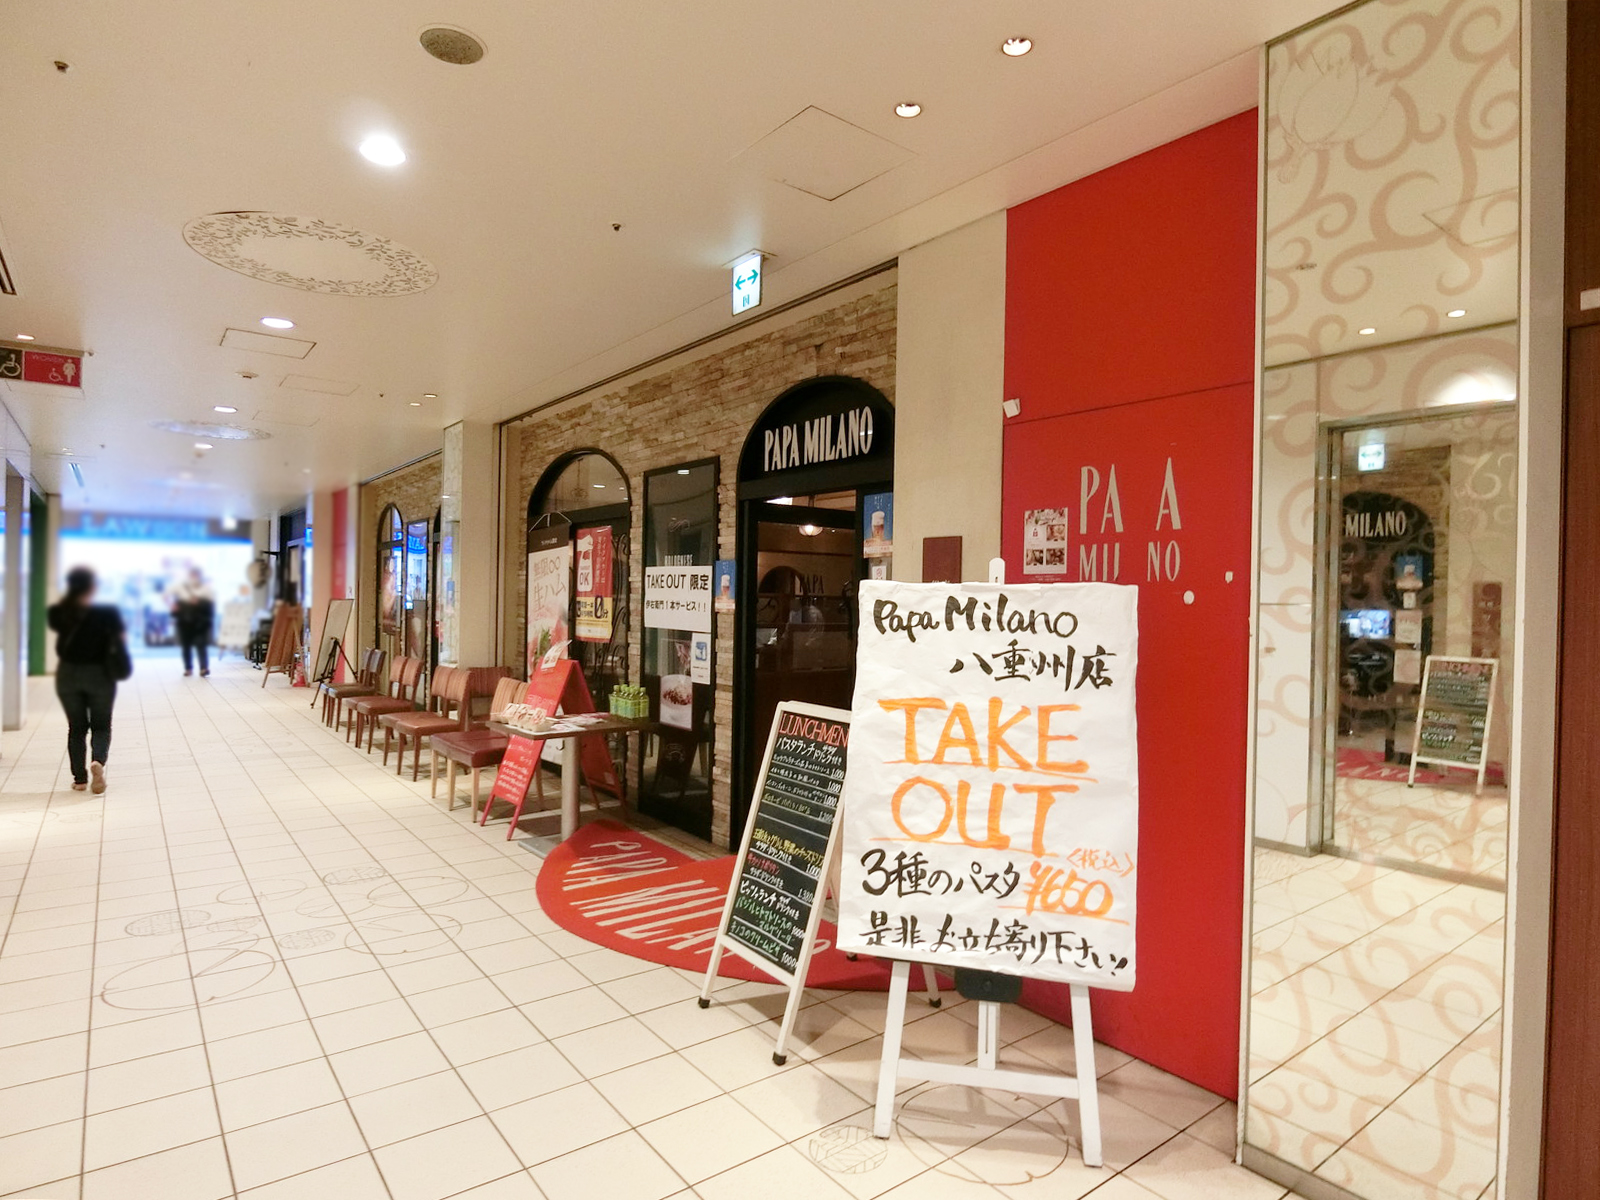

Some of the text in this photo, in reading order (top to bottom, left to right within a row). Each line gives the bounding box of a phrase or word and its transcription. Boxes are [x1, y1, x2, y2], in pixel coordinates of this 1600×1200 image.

[764, 406, 873, 472] PAPA MILANO
[1346, 511, 1406, 538] MILANO
[579, 571, 590, 586] OK
[646, 573, 709, 591] TAKE OUT 限定
[873, 594, 1078, 642] Papa Milano
[779, 713, 850, 748] LUNCHMEN
[877, 696, 1090, 773] TAKE
[890, 776, 1080, 857] OUT
[562, 841, 677, 891] PAPA
[861, 848, 1021, 898] 3種のパスタ
